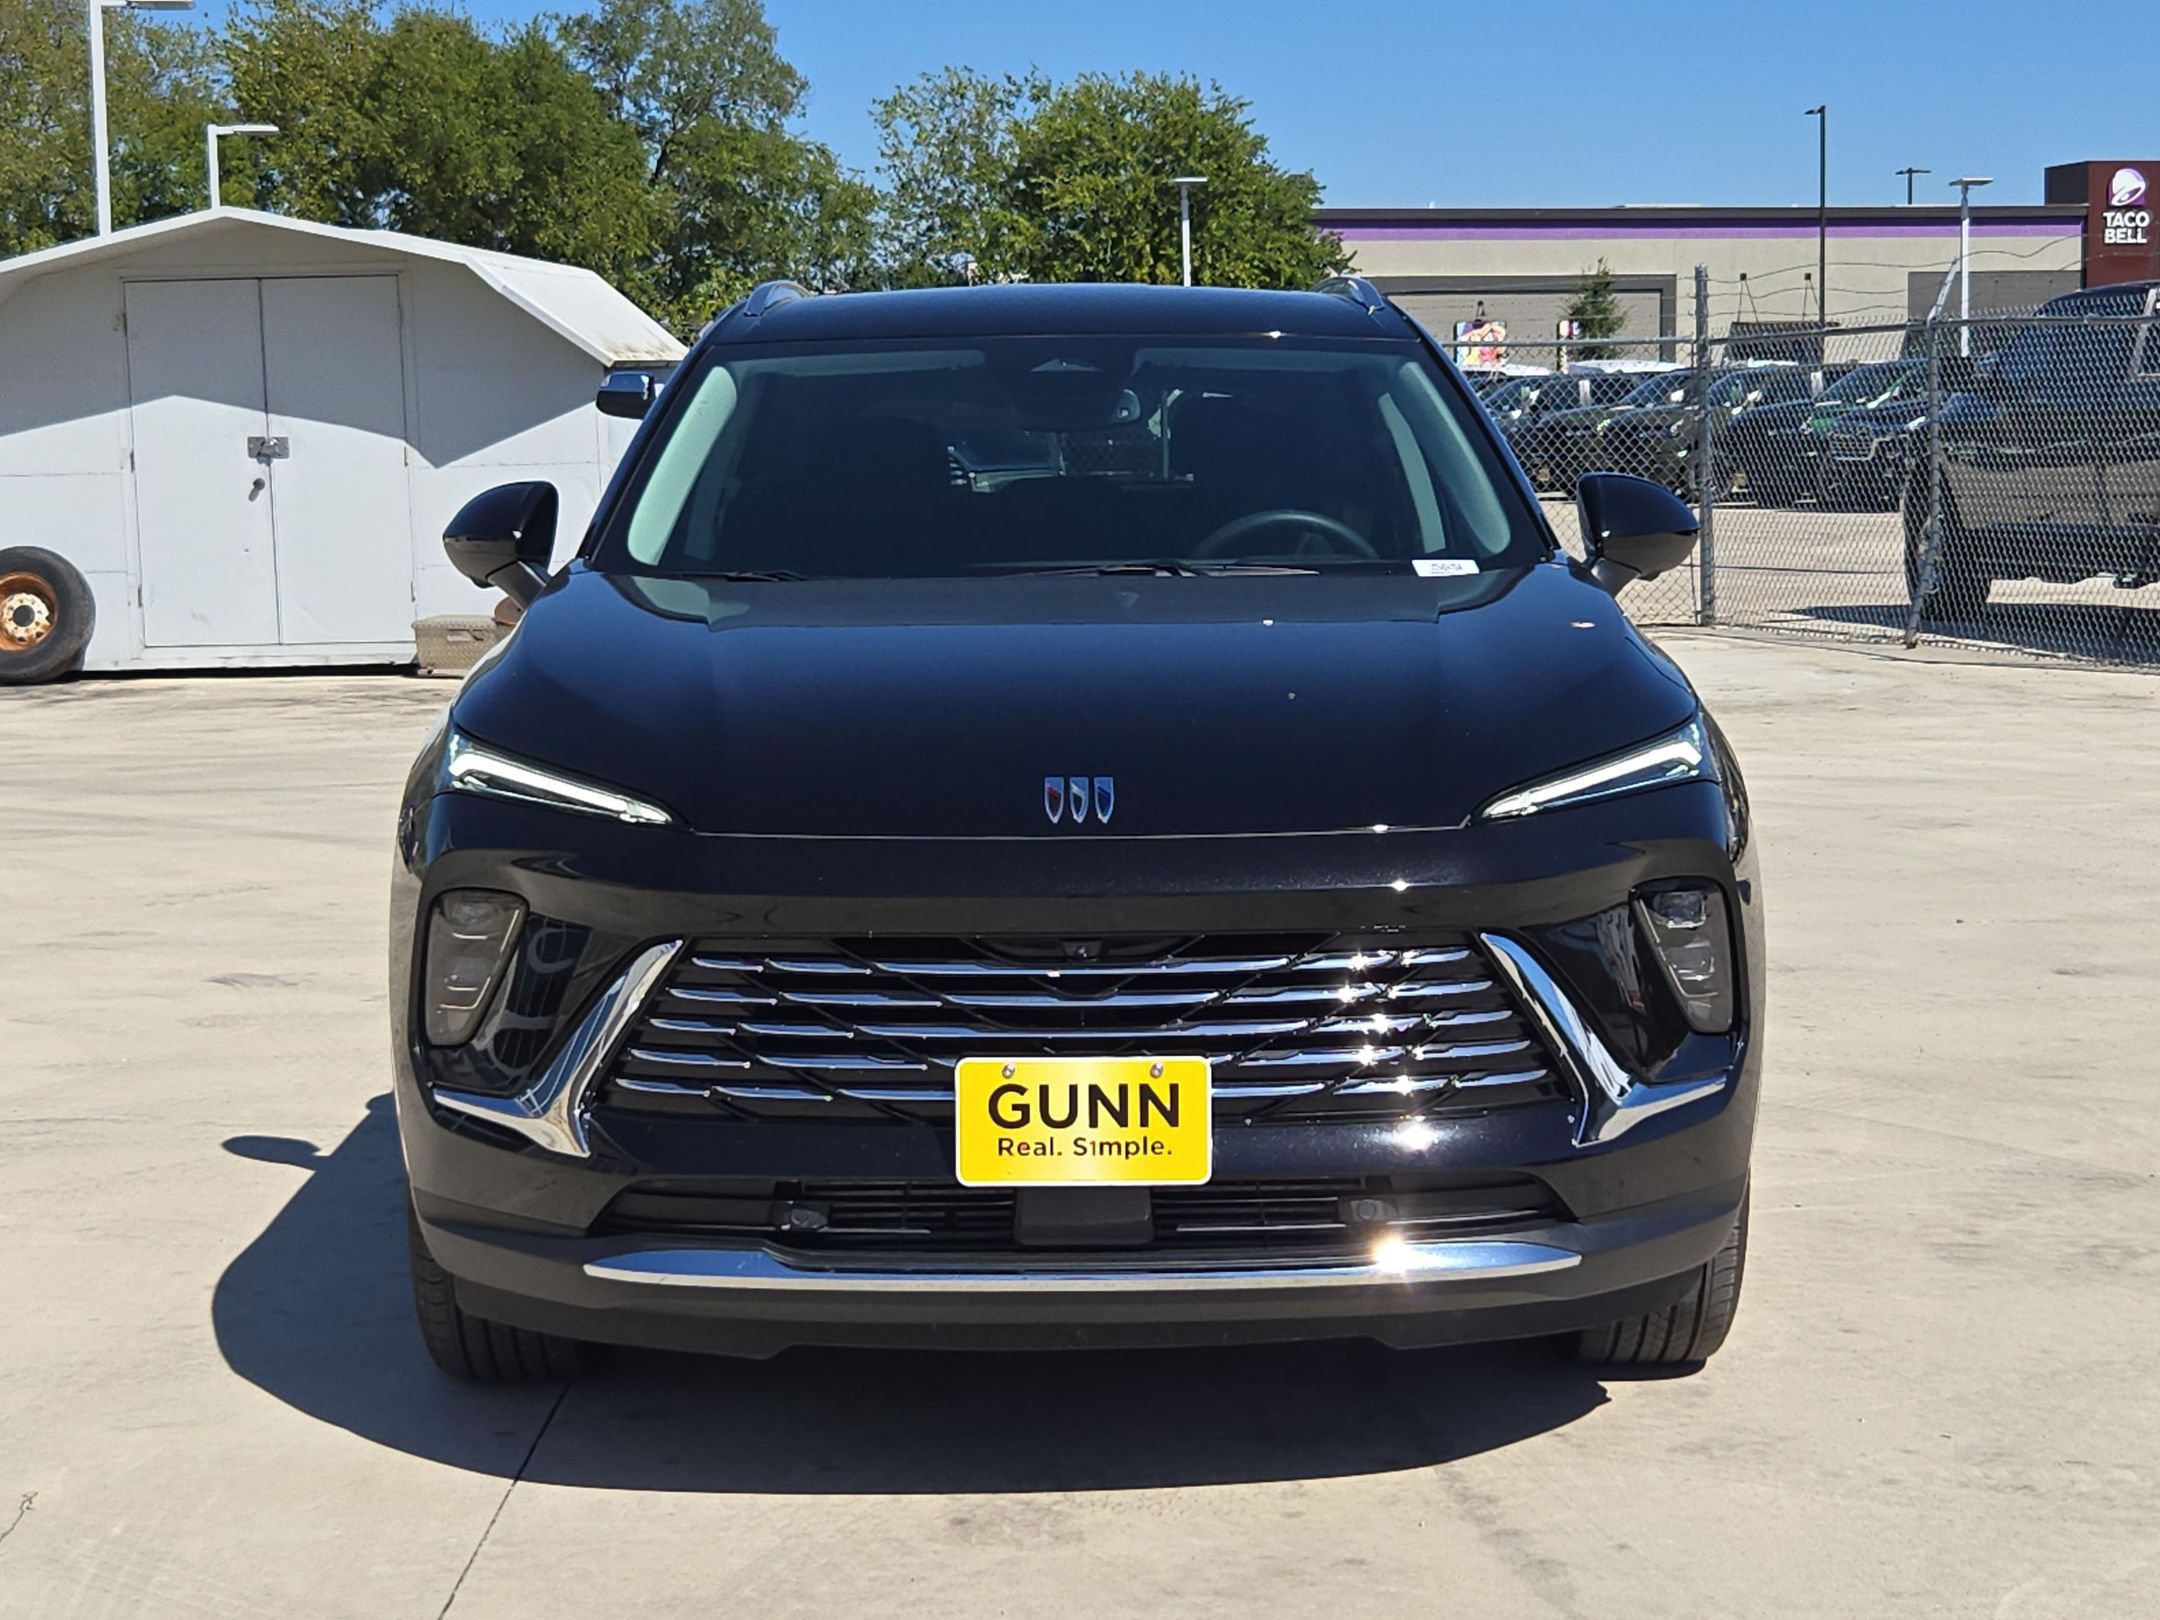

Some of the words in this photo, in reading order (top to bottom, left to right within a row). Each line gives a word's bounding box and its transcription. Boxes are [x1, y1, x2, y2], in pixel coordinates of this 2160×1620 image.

[2103, 211, 2150, 228] TACO
[2104, 228, 2148, 244] BELL
[988, 1083, 1180, 1129] GUNN
[998, 1137, 1063, 1157] Real.
